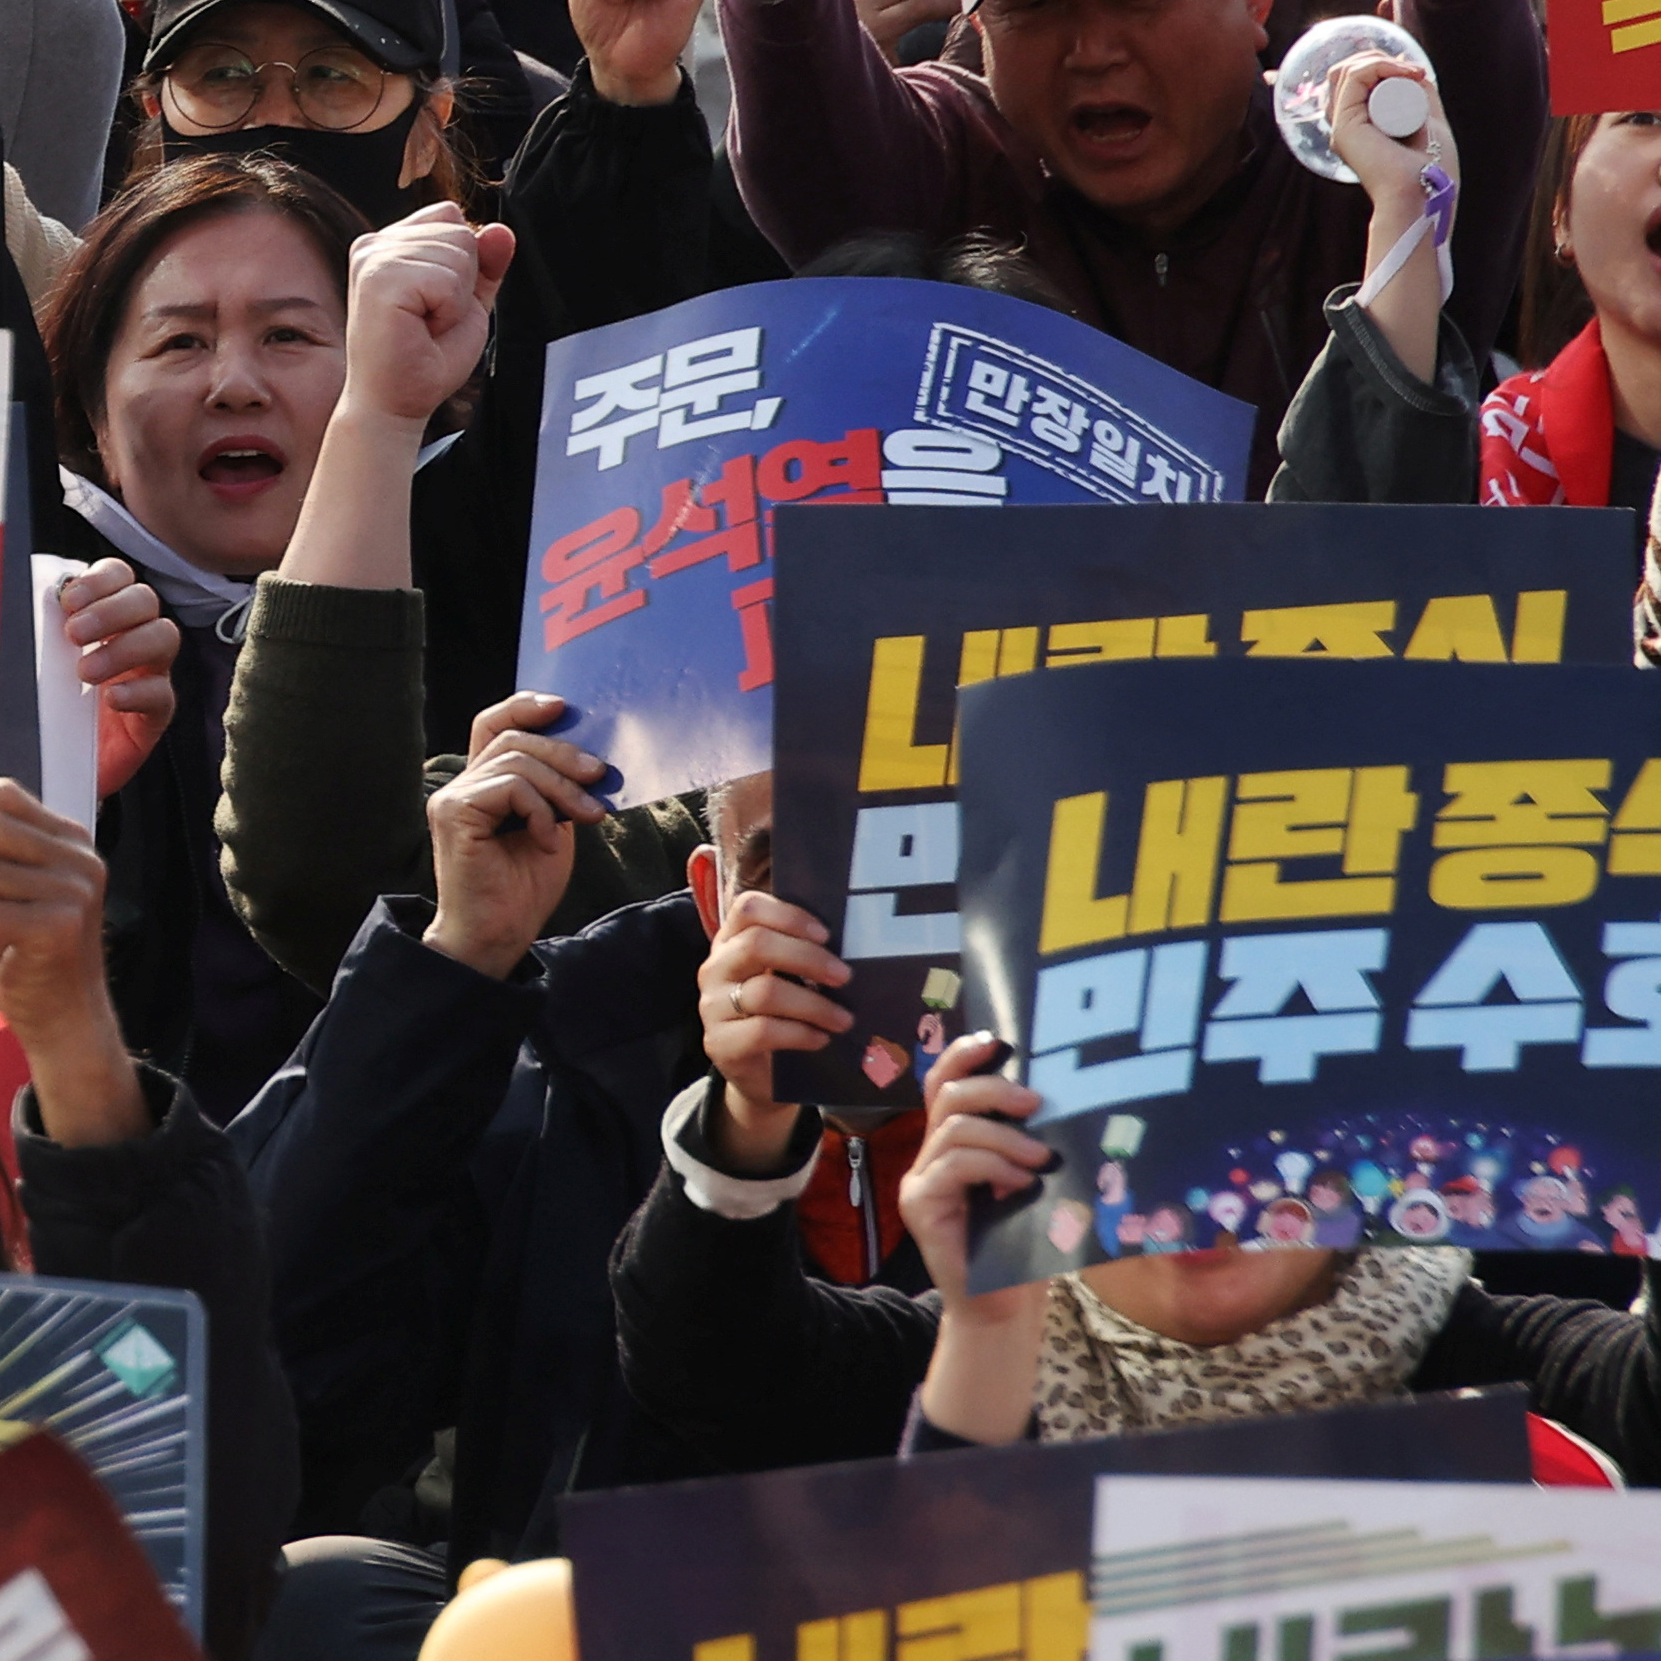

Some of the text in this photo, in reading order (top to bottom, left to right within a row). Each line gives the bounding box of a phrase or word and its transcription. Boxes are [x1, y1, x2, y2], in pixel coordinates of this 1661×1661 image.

[566, 325, 786, 473] 주문,
[1038, 764, 1420, 957] 내란
[1024, 927, 1390, 1128] 민주
